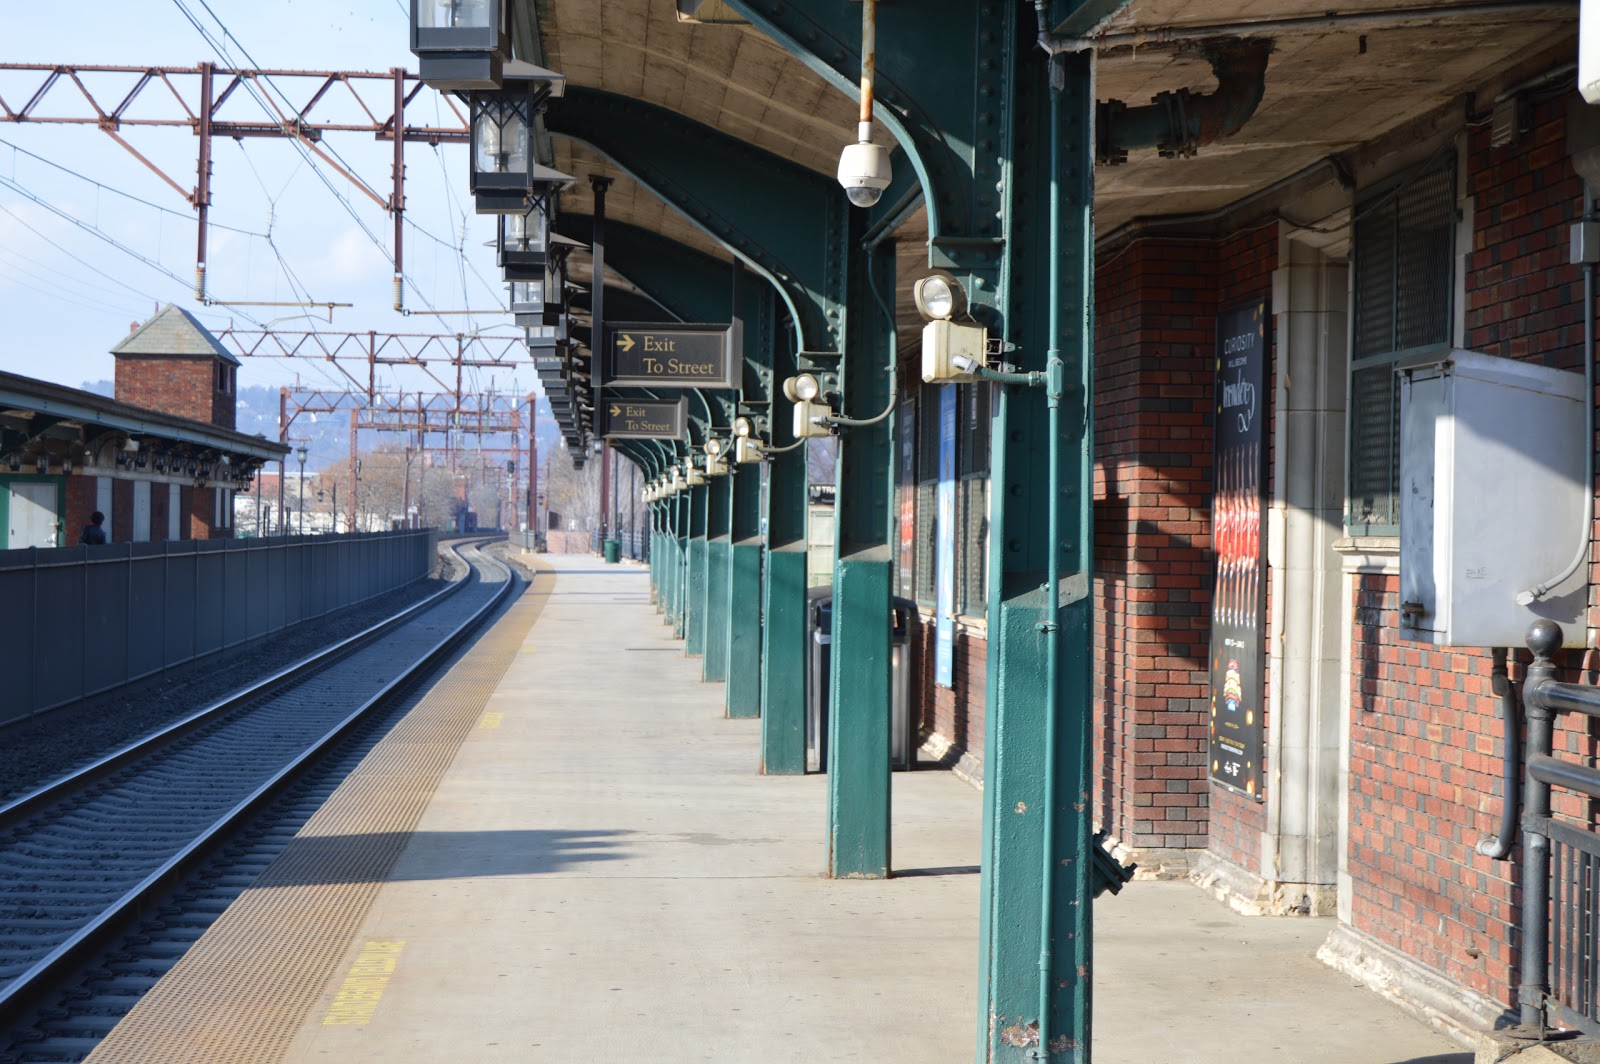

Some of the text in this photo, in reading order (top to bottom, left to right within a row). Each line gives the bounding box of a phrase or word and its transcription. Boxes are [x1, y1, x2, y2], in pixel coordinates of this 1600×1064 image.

[644, 336, 675, 352] Exit
[1224, 332, 1255, 354] CURIOSITY
[643, 358, 714, 374] To Street
[626, 407, 646, 417] Exit
[626, 421, 670, 431] To Street
